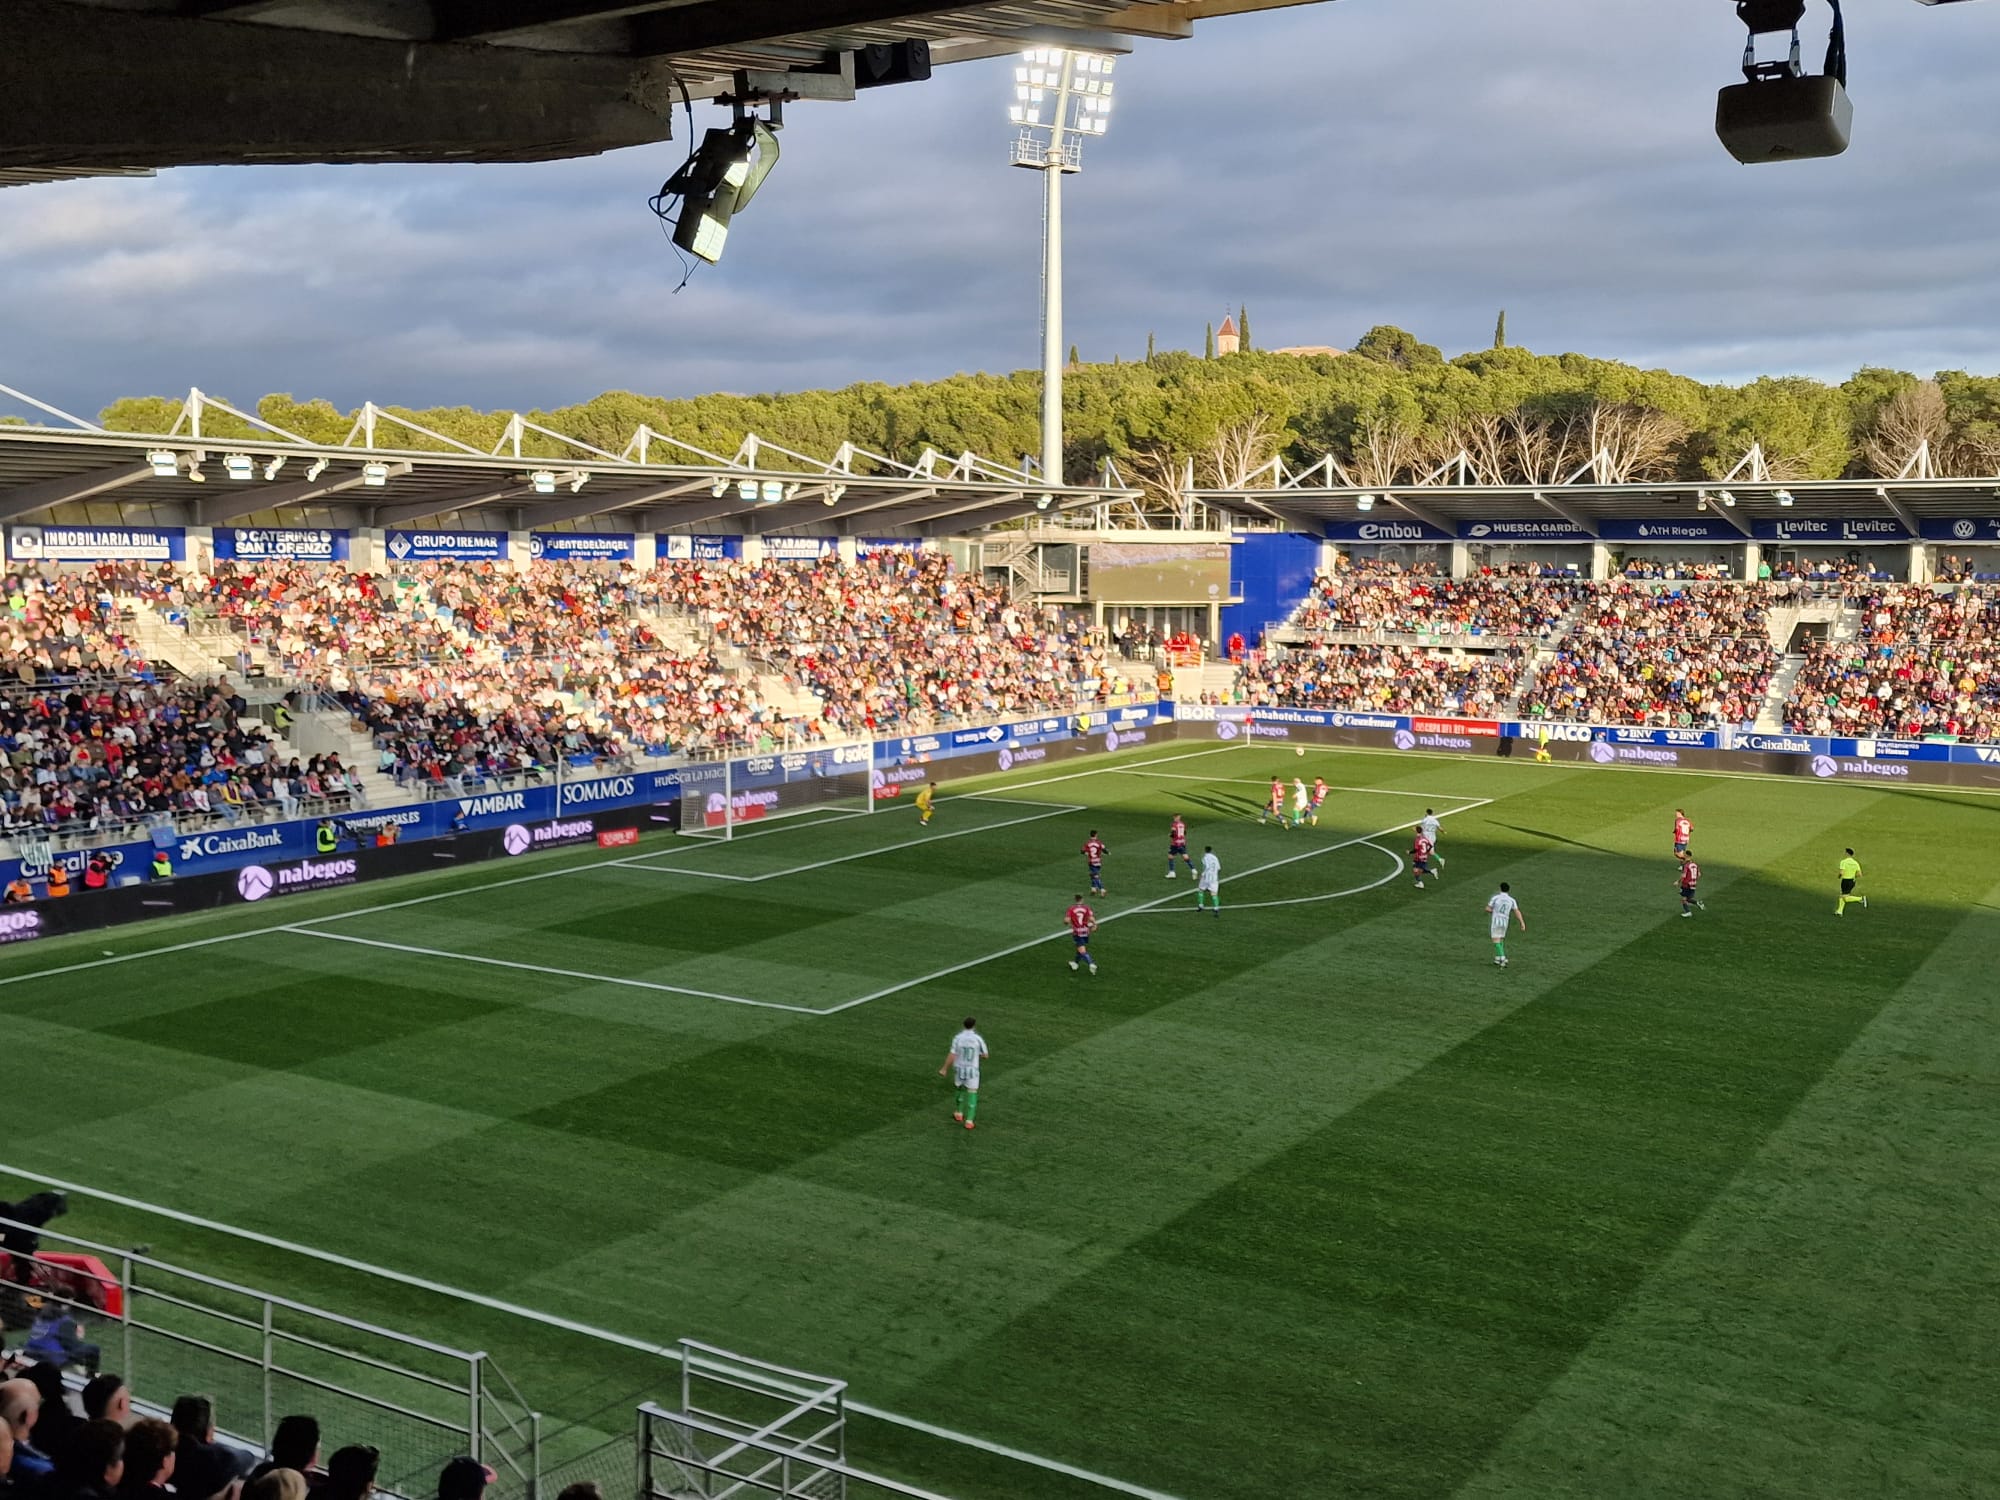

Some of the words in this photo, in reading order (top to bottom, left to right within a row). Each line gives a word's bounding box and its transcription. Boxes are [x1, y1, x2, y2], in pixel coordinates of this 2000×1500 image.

[1358, 522, 1422, 539] embou
[1493, 523, 1540, 532] HUESCA
[44, 532, 129, 546] INMOBILIARIA
[132, 533, 157, 546] BUIL
[250, 530, 318, 542] CATERING
[413, 535, 456, 548] GRUPO
[457, 536, 498, 548] IREMAR
[235, 542, 265, 554] SAN
[268, 542, 332, 554] LORENZO
[1251, 709, 1325, 723] abbahotels.com
[1241, 724, 1289, 737] nabegos
[1419, 734, 1472, 748] nabegos
[1750, 737, 1812, 752] CaixaBank
[1619, 746, 1678, 761] nabegos
[1843, 760, 1909, 775] nabegos
[887, 767, 926, 783] nabegos
[563, 777, 635, 805] SOMMOS
[471, 793, 526, 816] AMBAR
[534, 820, 594, 841] nabegos
[204, 828, 283, 855] CaixaBank
[1421, 842, 1427, 853] 3
[1090, 847, 1098, 858] 2
[278, 858, 357, 885] nabegos
[1499, 904, 1506, 914] 4
[1078, 913, 1084, 925] 7
[961, 1046, 975, 1062] 10
